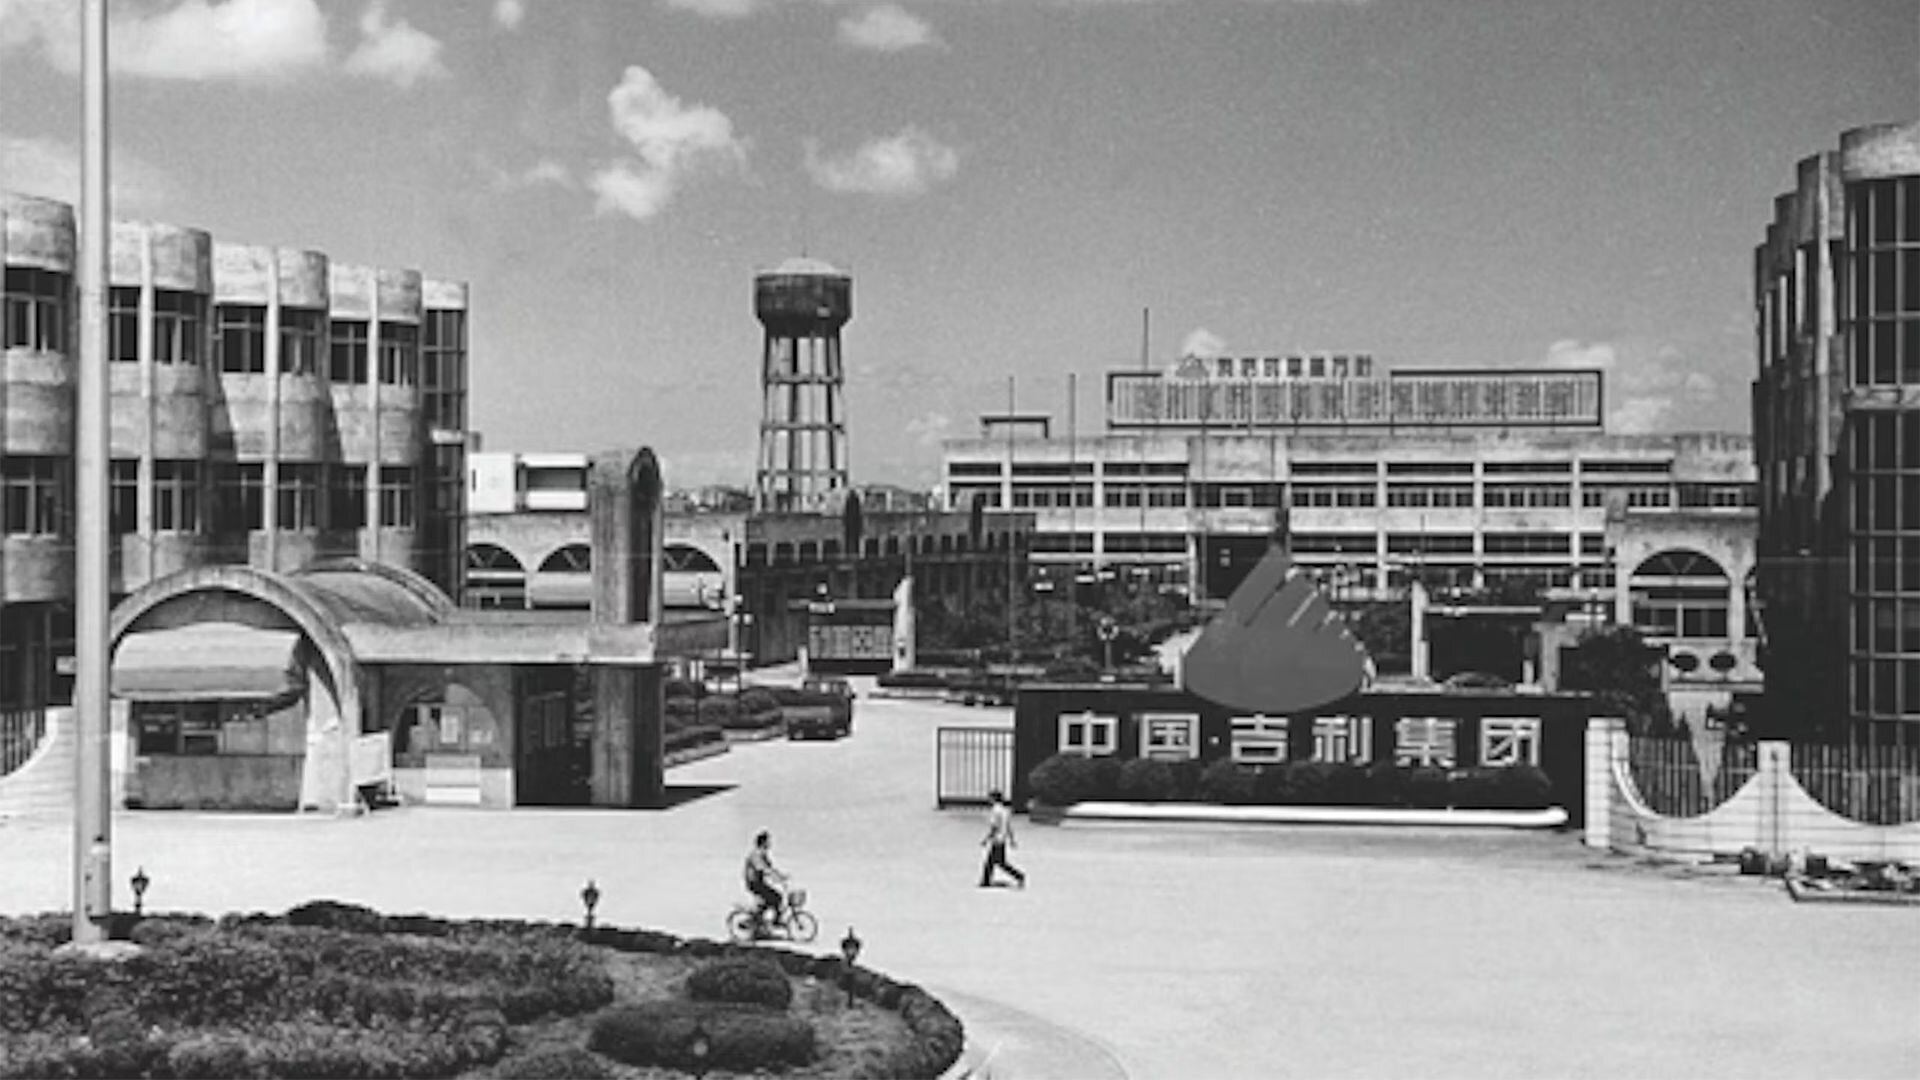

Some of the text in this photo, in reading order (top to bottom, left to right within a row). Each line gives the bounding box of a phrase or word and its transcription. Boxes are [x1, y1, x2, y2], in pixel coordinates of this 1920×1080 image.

[1057, 709, 1543, 767] 中国·吉利集团
